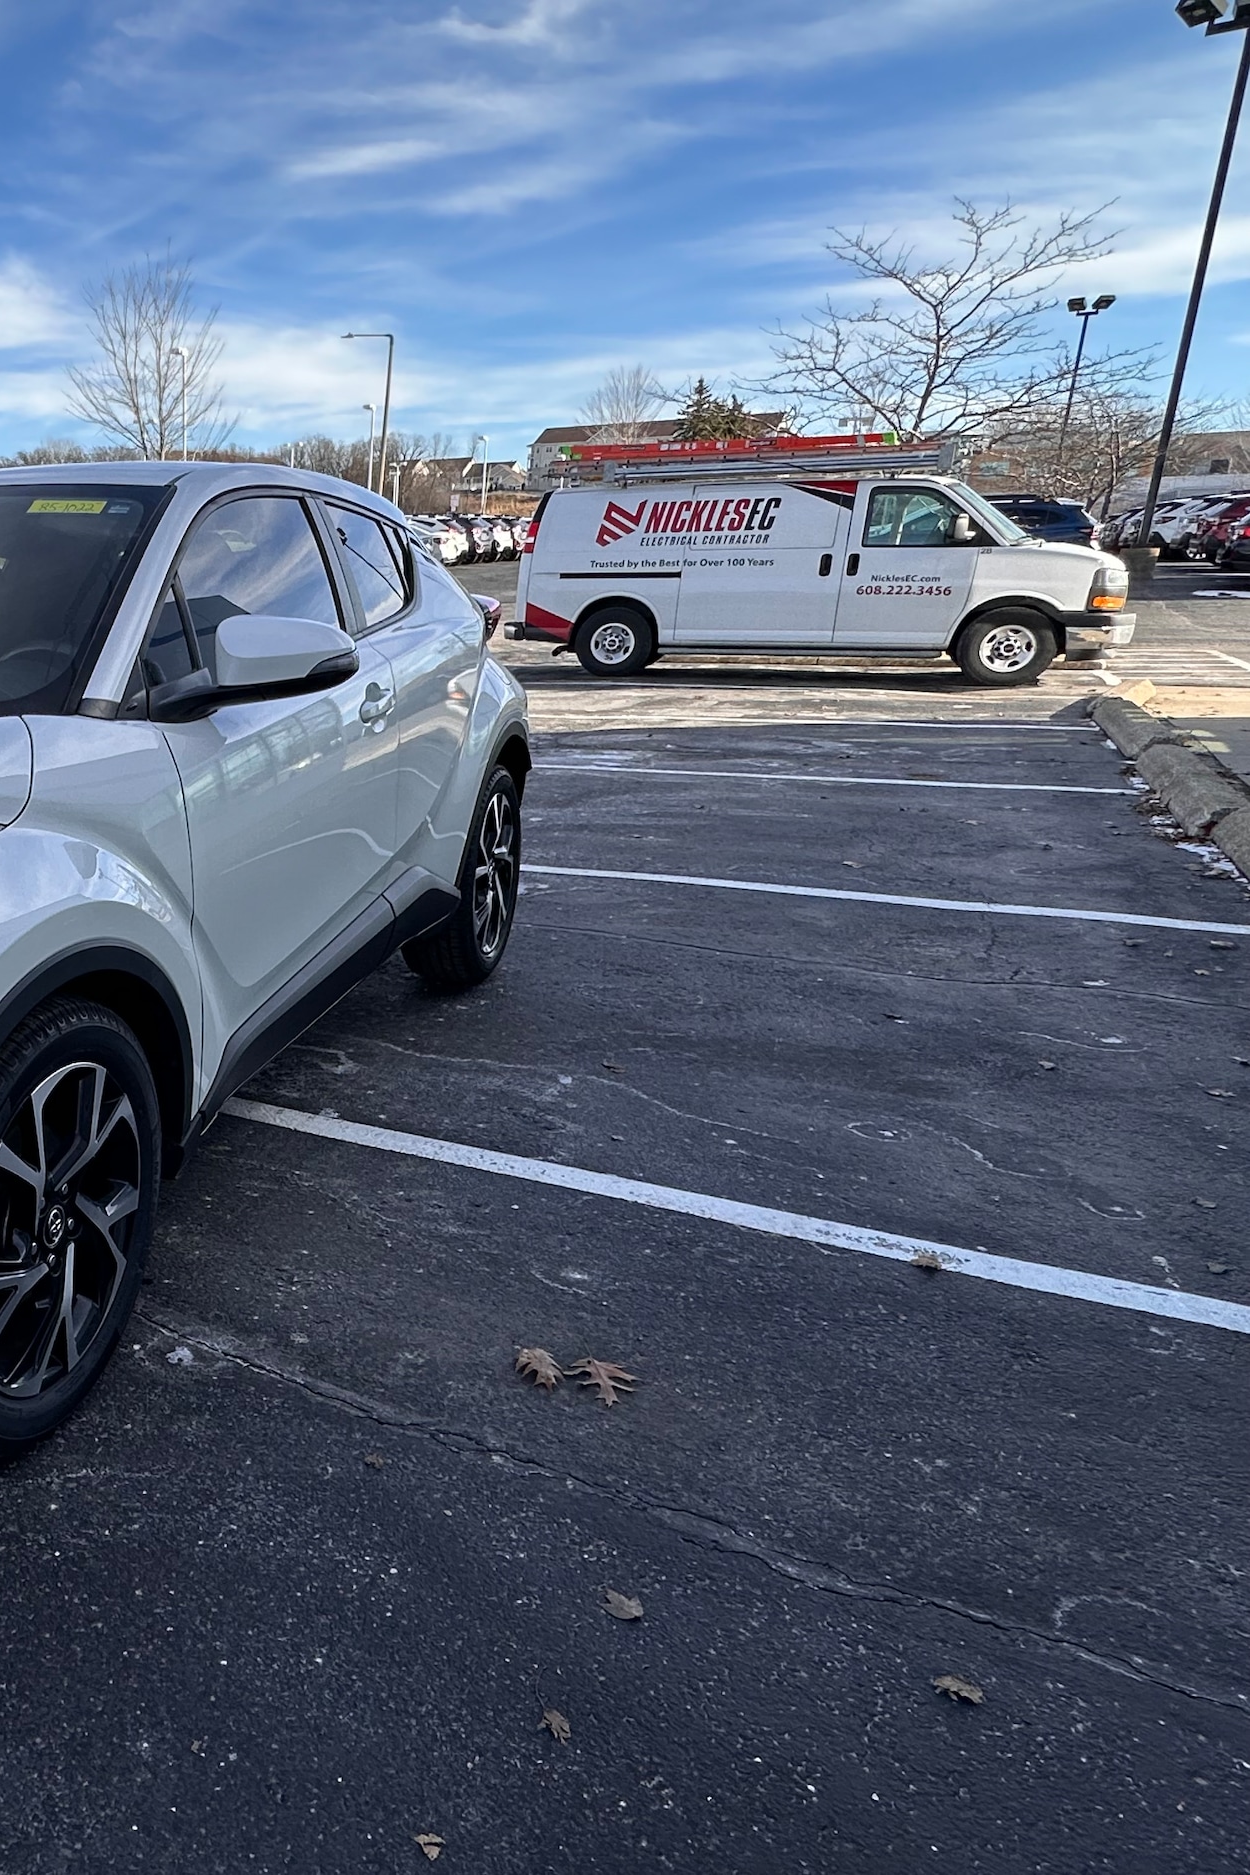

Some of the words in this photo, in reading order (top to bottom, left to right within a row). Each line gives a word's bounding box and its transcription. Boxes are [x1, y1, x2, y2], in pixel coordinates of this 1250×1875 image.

[644, 498, 782, 534] NICKLESEC
[640, 535, 698, 547] ELECTRICAL
[701, 533, 770, 545] CONTRACTOR
[590, 560, 625, 569] Trusted
[626, 559, 639, 570] by
[641, 559, 657, 568] the
[658, 559, 681, 568] Best
[682, 558, 697, 567] for
[699, 558, 725, 567] Over
[726, 558, 745, 567] 100
[747, 557, 775, 567] Years
[870, 574, 941, 583] NicklesEC.com
[856, 585, 952, 596] 608.222.3456
